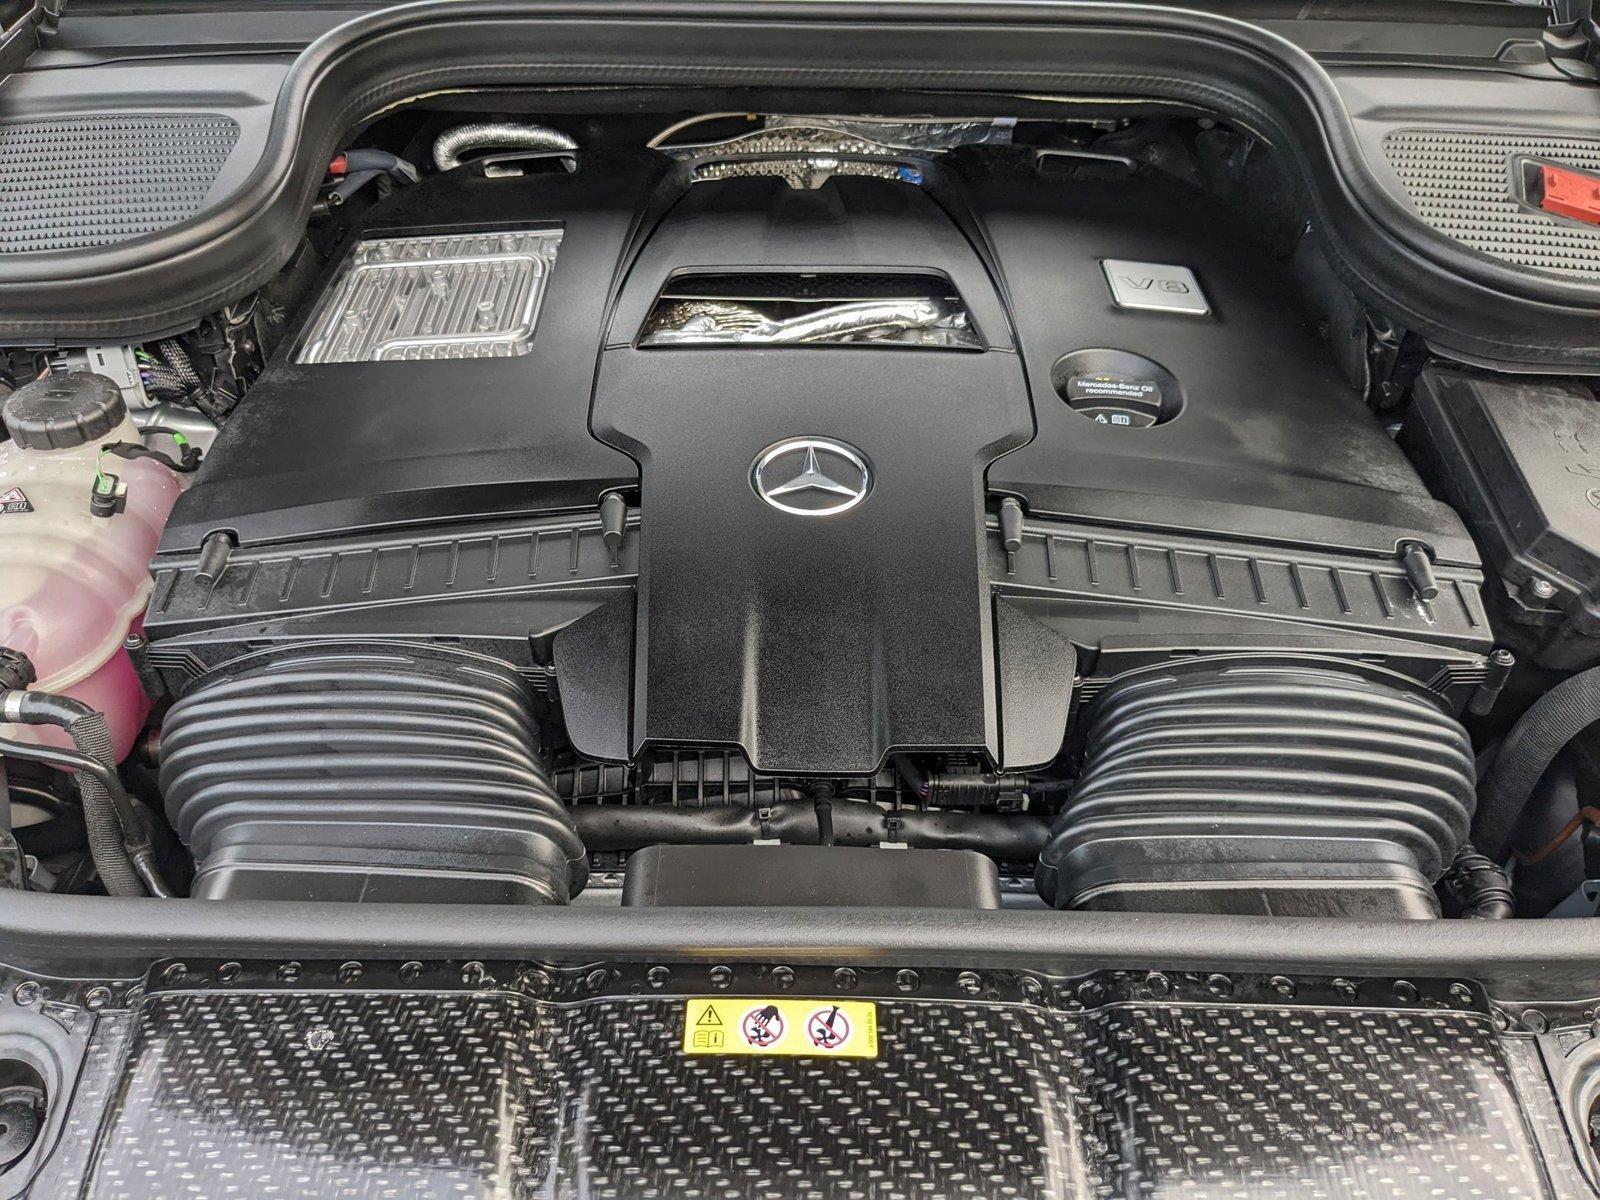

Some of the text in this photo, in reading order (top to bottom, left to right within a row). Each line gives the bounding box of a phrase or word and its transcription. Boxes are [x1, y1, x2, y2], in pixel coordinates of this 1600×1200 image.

[1077, 381, 1153, 393] Mercedes-Benz Oil
[1085, 388, 1143, 397] recommended
